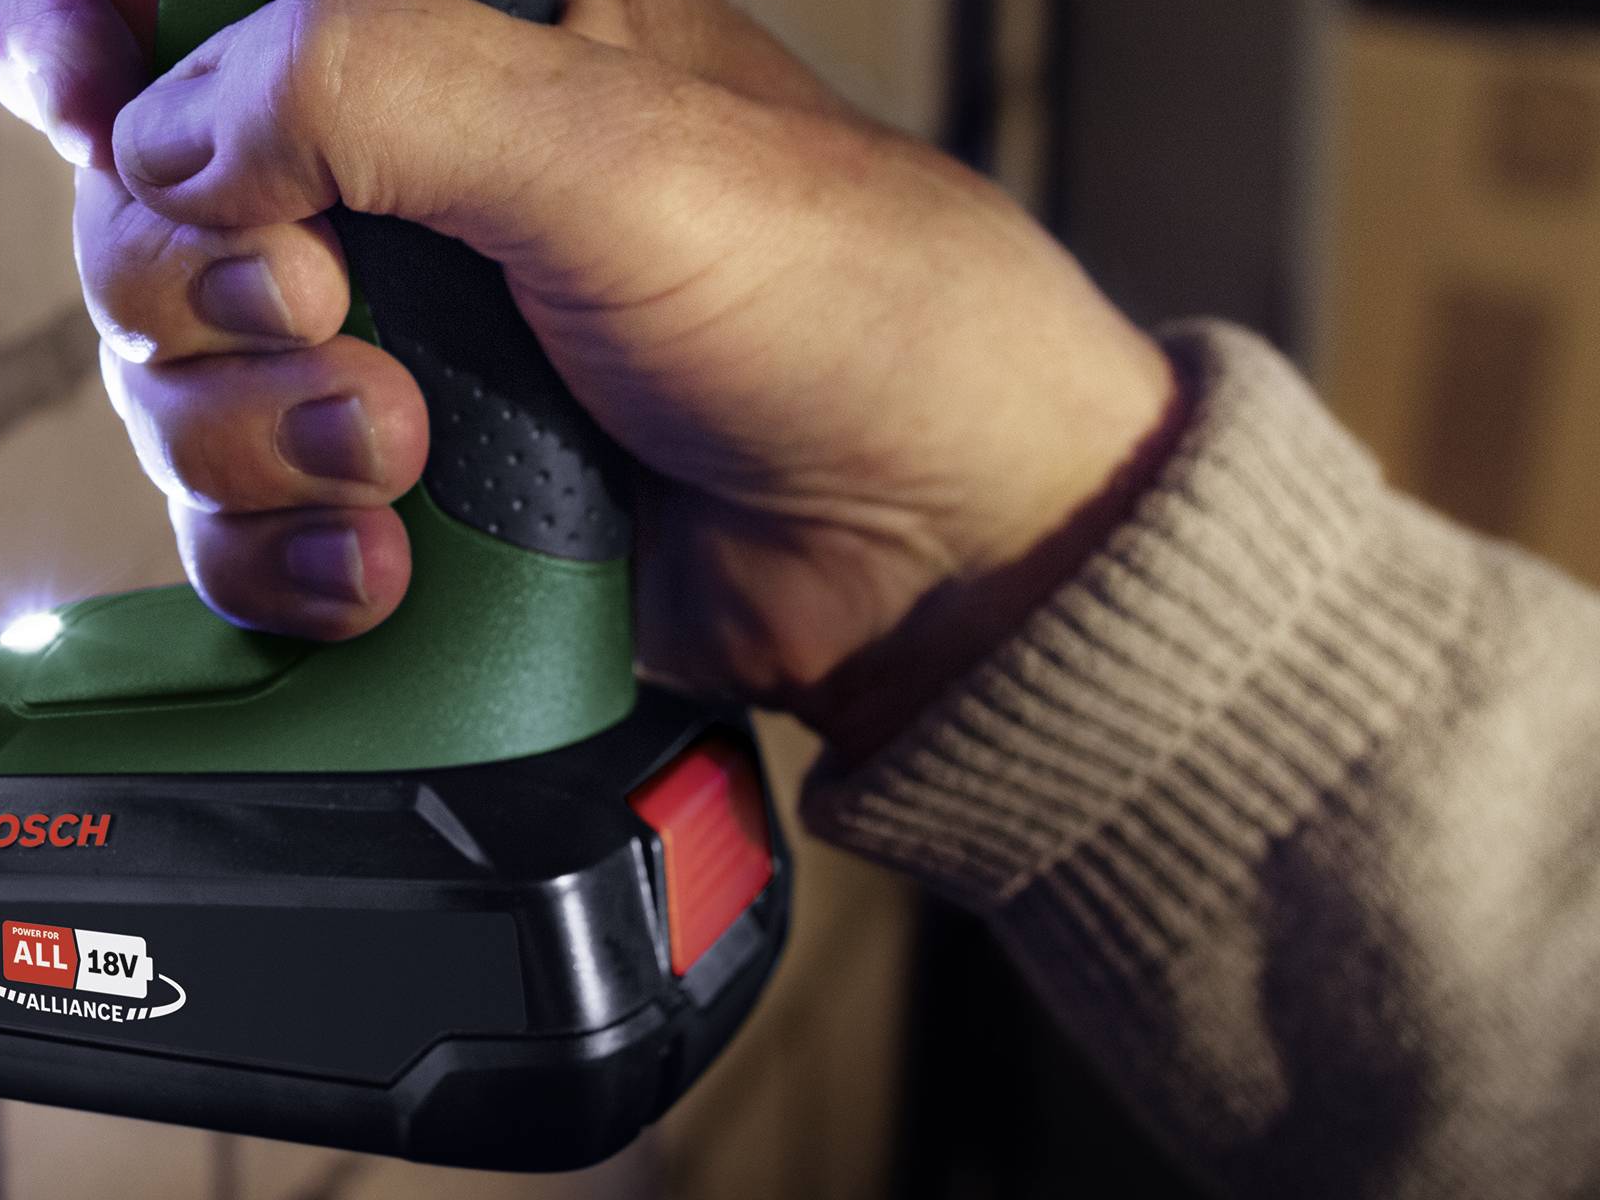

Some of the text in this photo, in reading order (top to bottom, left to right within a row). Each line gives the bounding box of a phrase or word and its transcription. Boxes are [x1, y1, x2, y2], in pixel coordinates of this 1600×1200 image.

[12, 927, 59, 940] POWER FOR
[13, 940, 68, 970] ALL
[87, 949, 138, 978] 18V
[26, 993, 123, 1023] ALLIANCE
